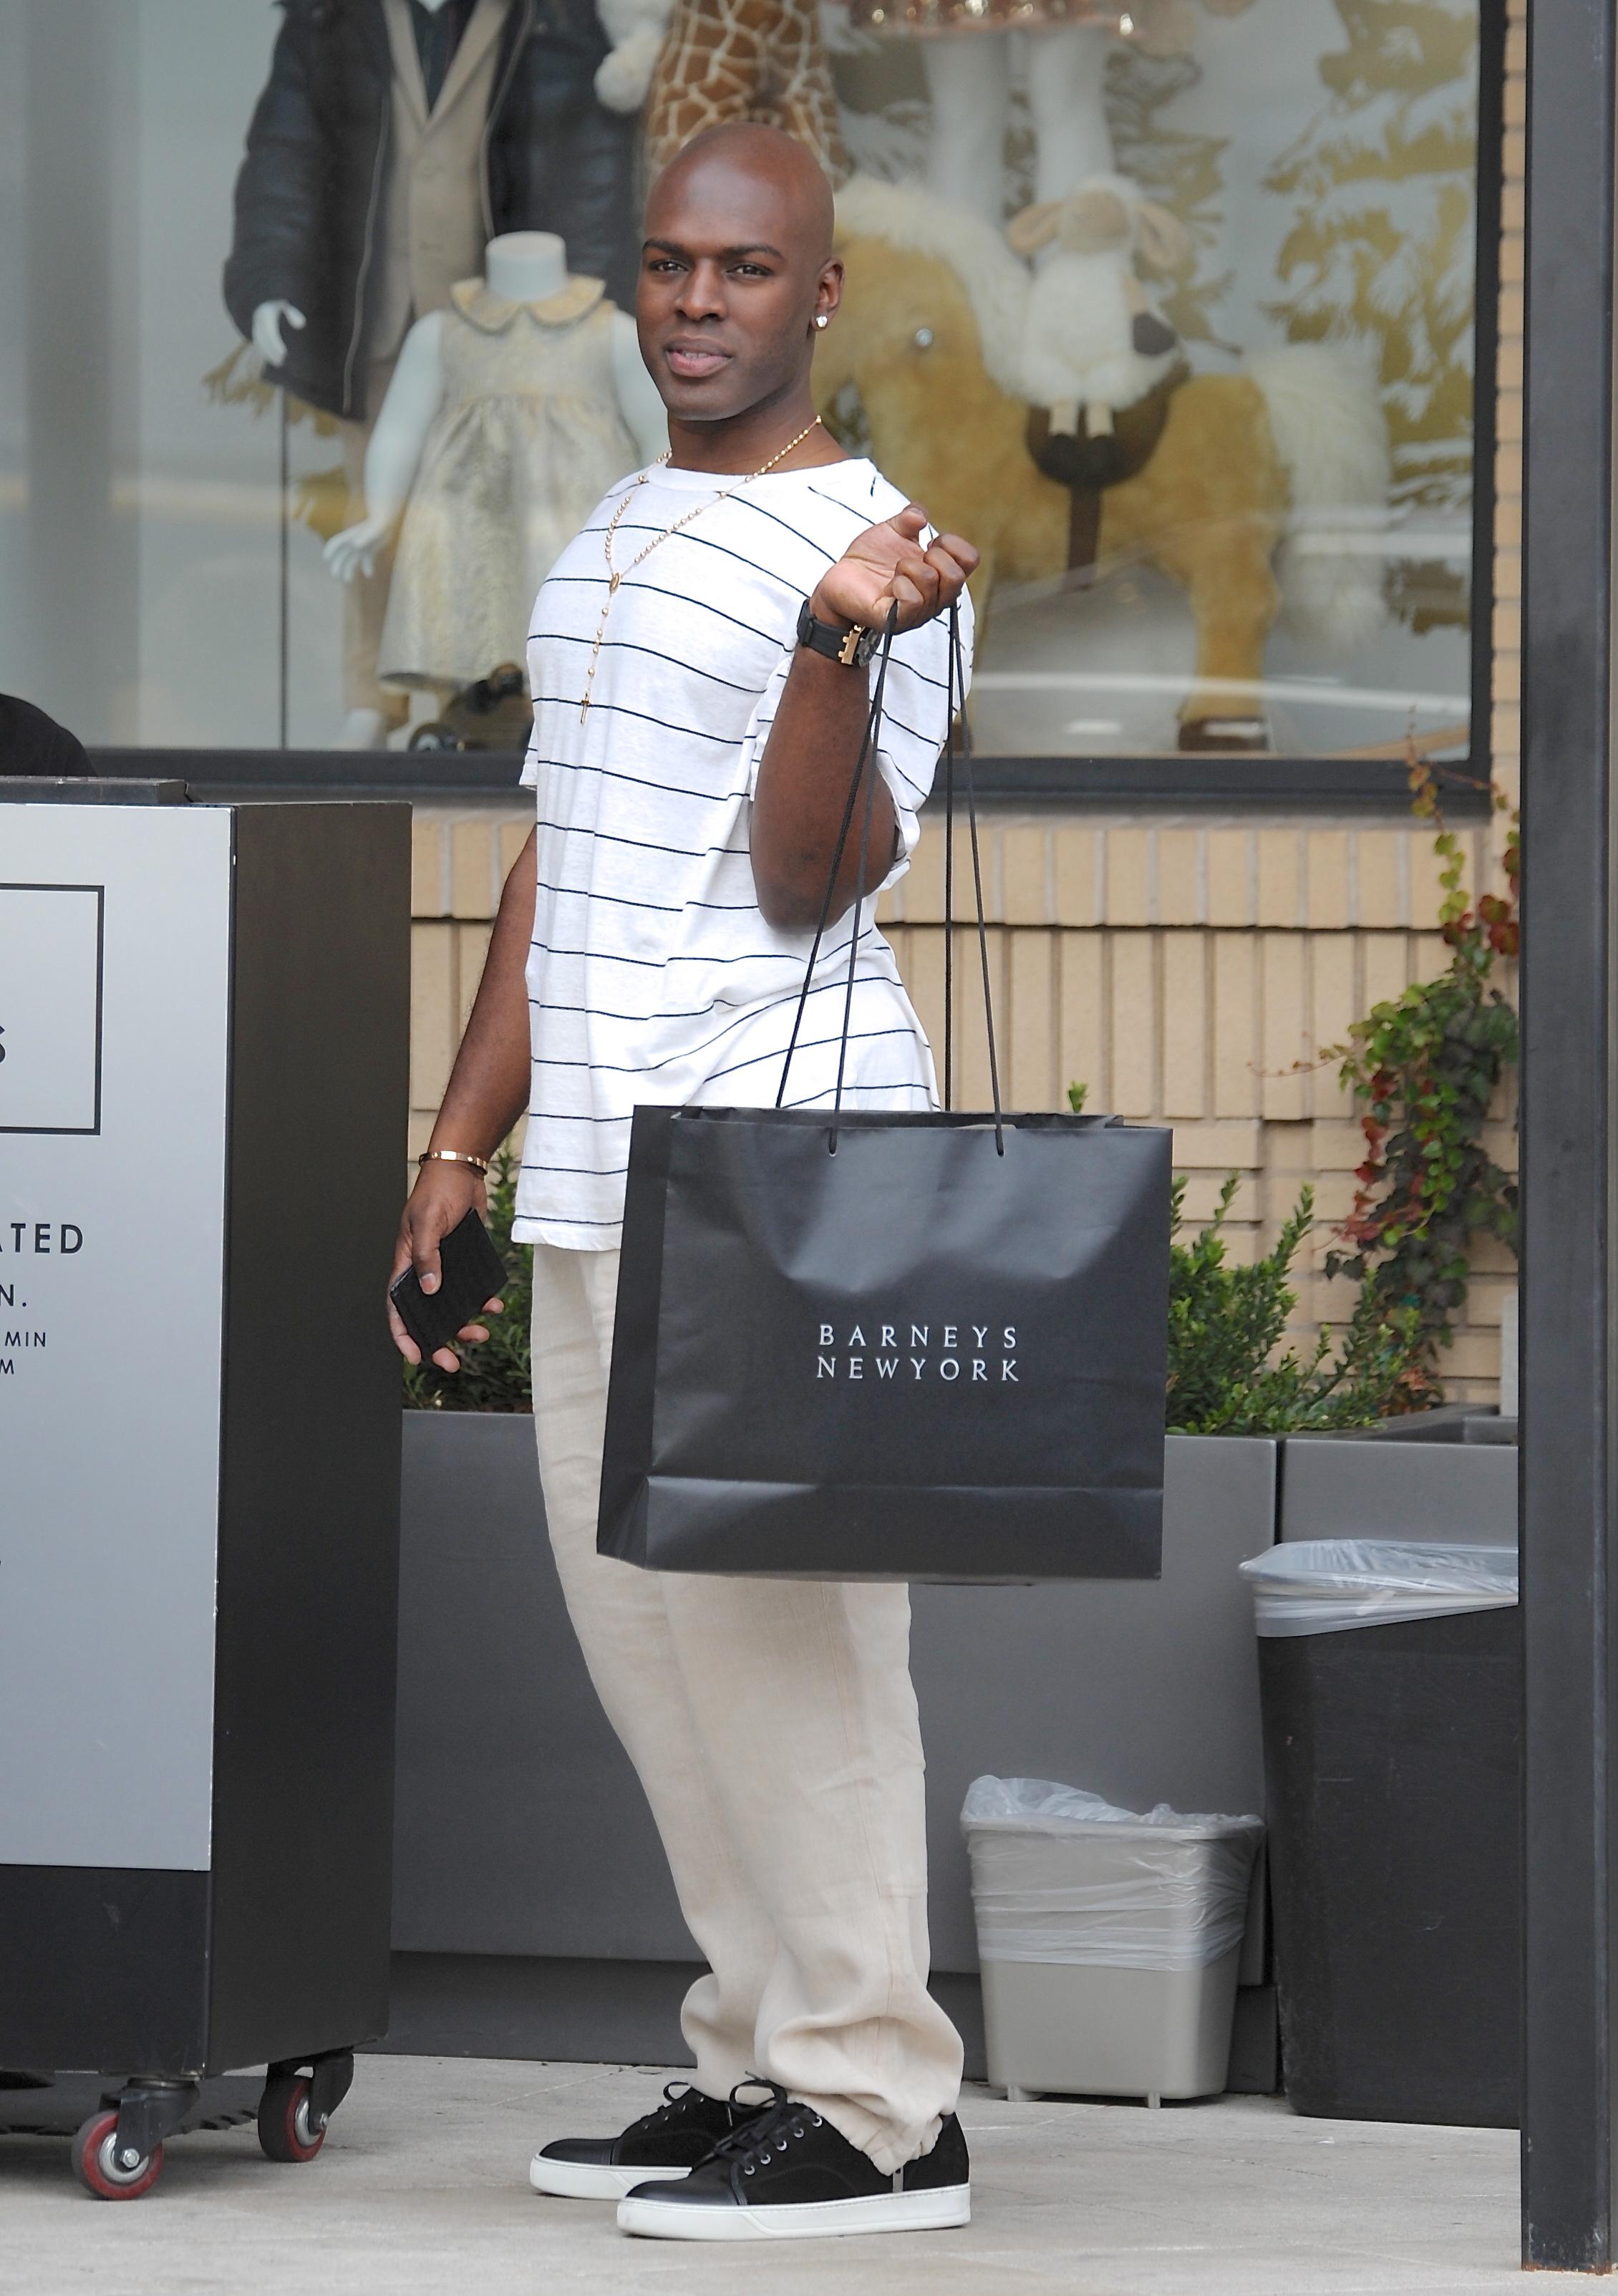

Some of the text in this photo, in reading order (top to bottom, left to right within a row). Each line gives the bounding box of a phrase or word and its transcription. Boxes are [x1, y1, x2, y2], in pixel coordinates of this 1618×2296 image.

[0, 1223, 83, 1254] TED
[5, 1332, 46, 1347] MIN
[819, 1323, 1017, 1349] BARNEYS
